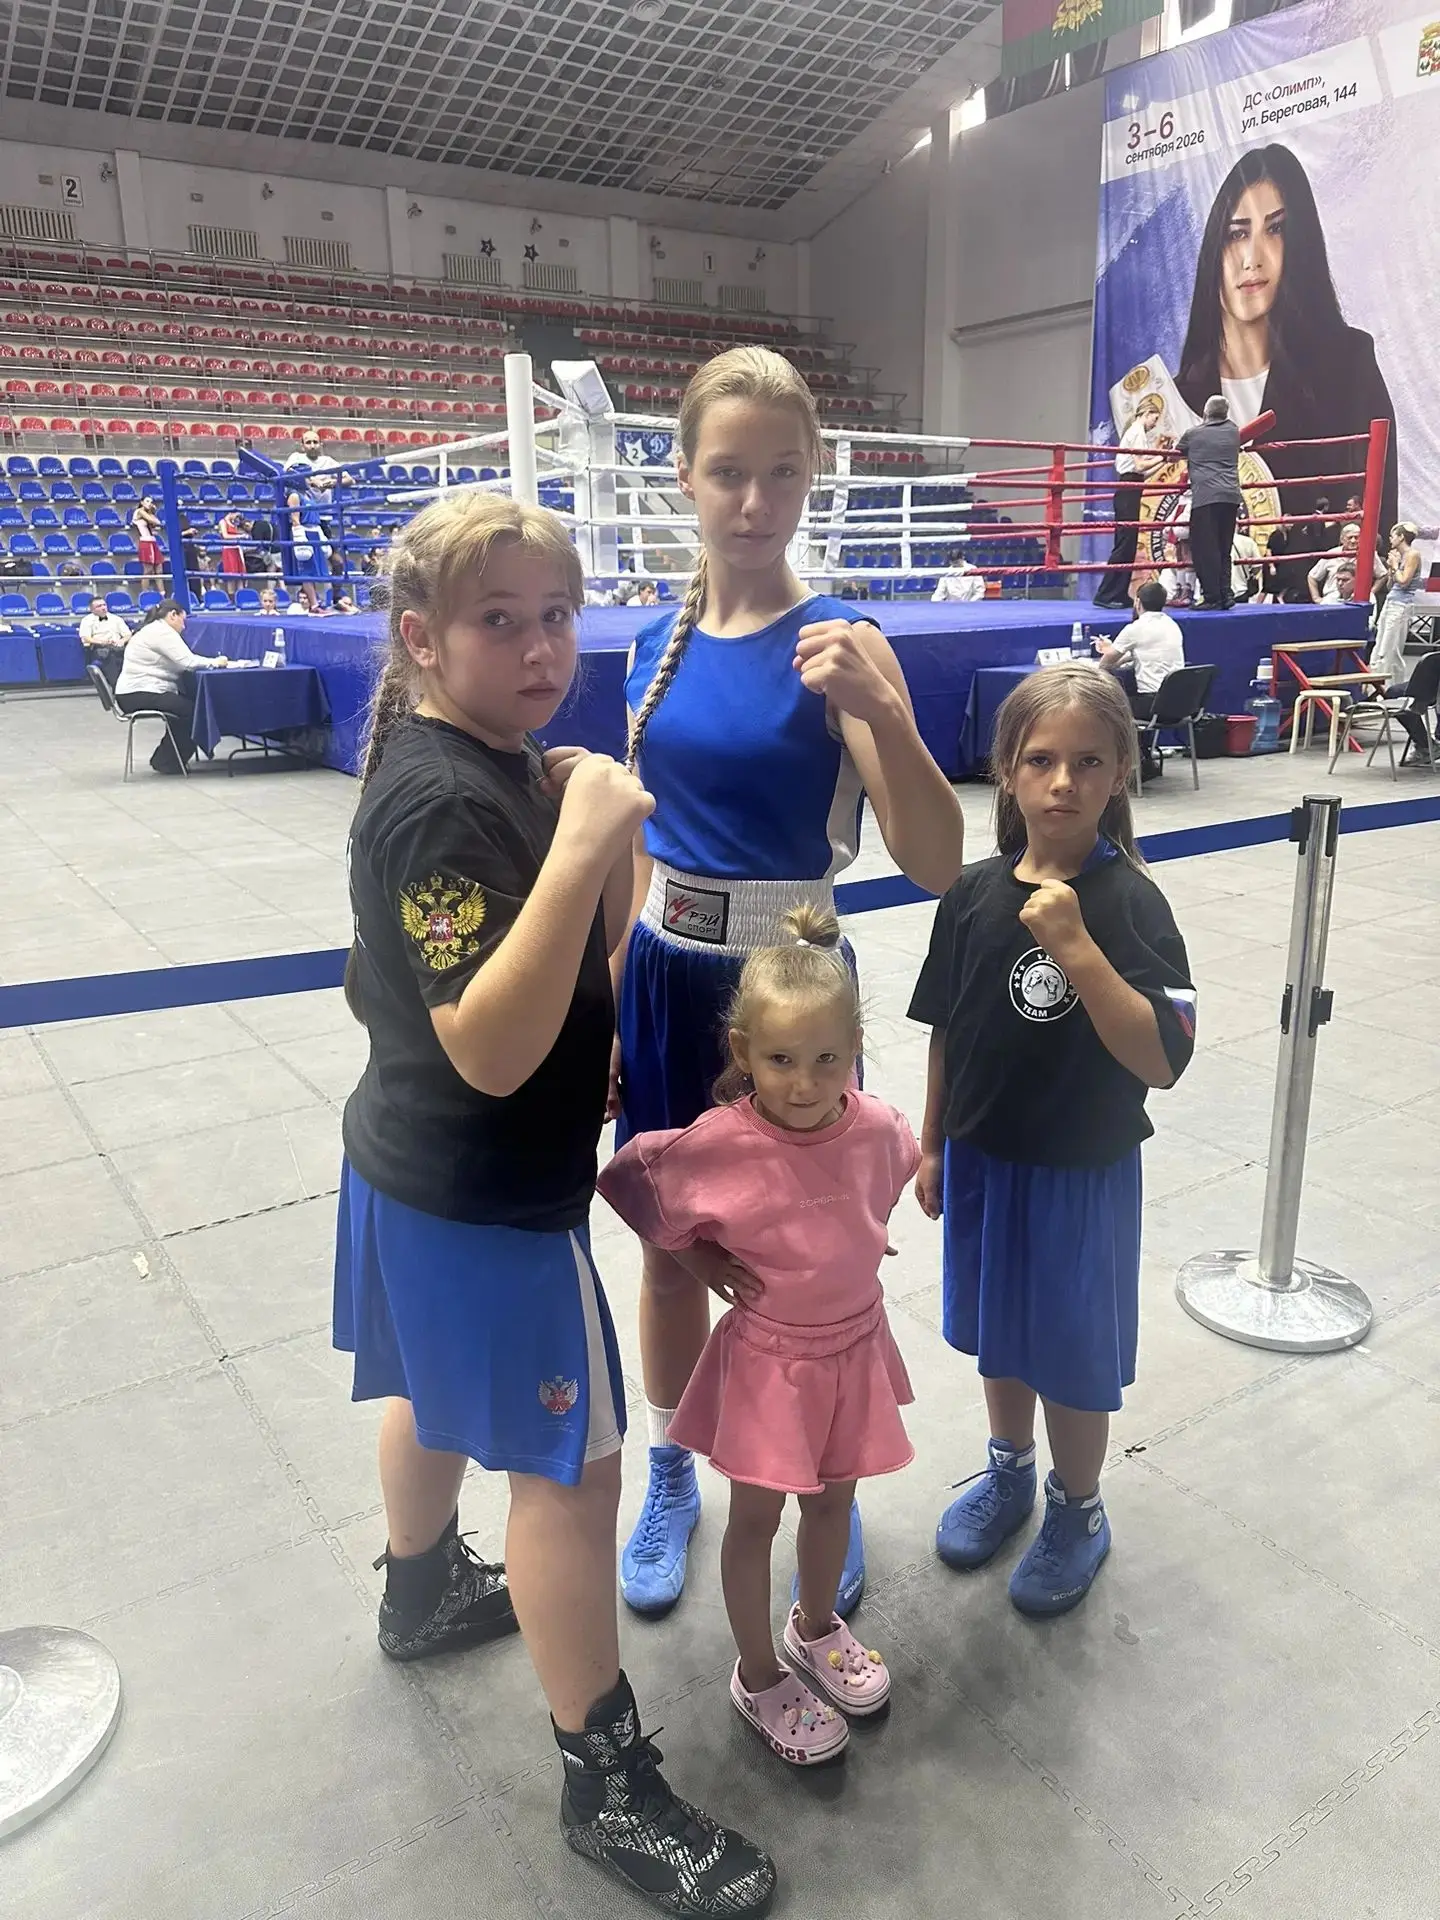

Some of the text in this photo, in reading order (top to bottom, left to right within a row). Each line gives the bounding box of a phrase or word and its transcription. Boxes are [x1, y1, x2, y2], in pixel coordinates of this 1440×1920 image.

[1243, 75, 1326, 112] ДС «Олимп»,
[1241, 82, 1357, 133] ул. Береговая, 144
[1125, 129, 1205, 165] сентября 2026
[65, 178, 78, 198] 2
[707, 254, 712, 270] 1
[631, 447, 639, 459] 2
[688, 910, 721, 927] РЭЙ
[687, 923, 719, 936] СПОРТ
[1022, 1003, 1048, 1018] TEAM
